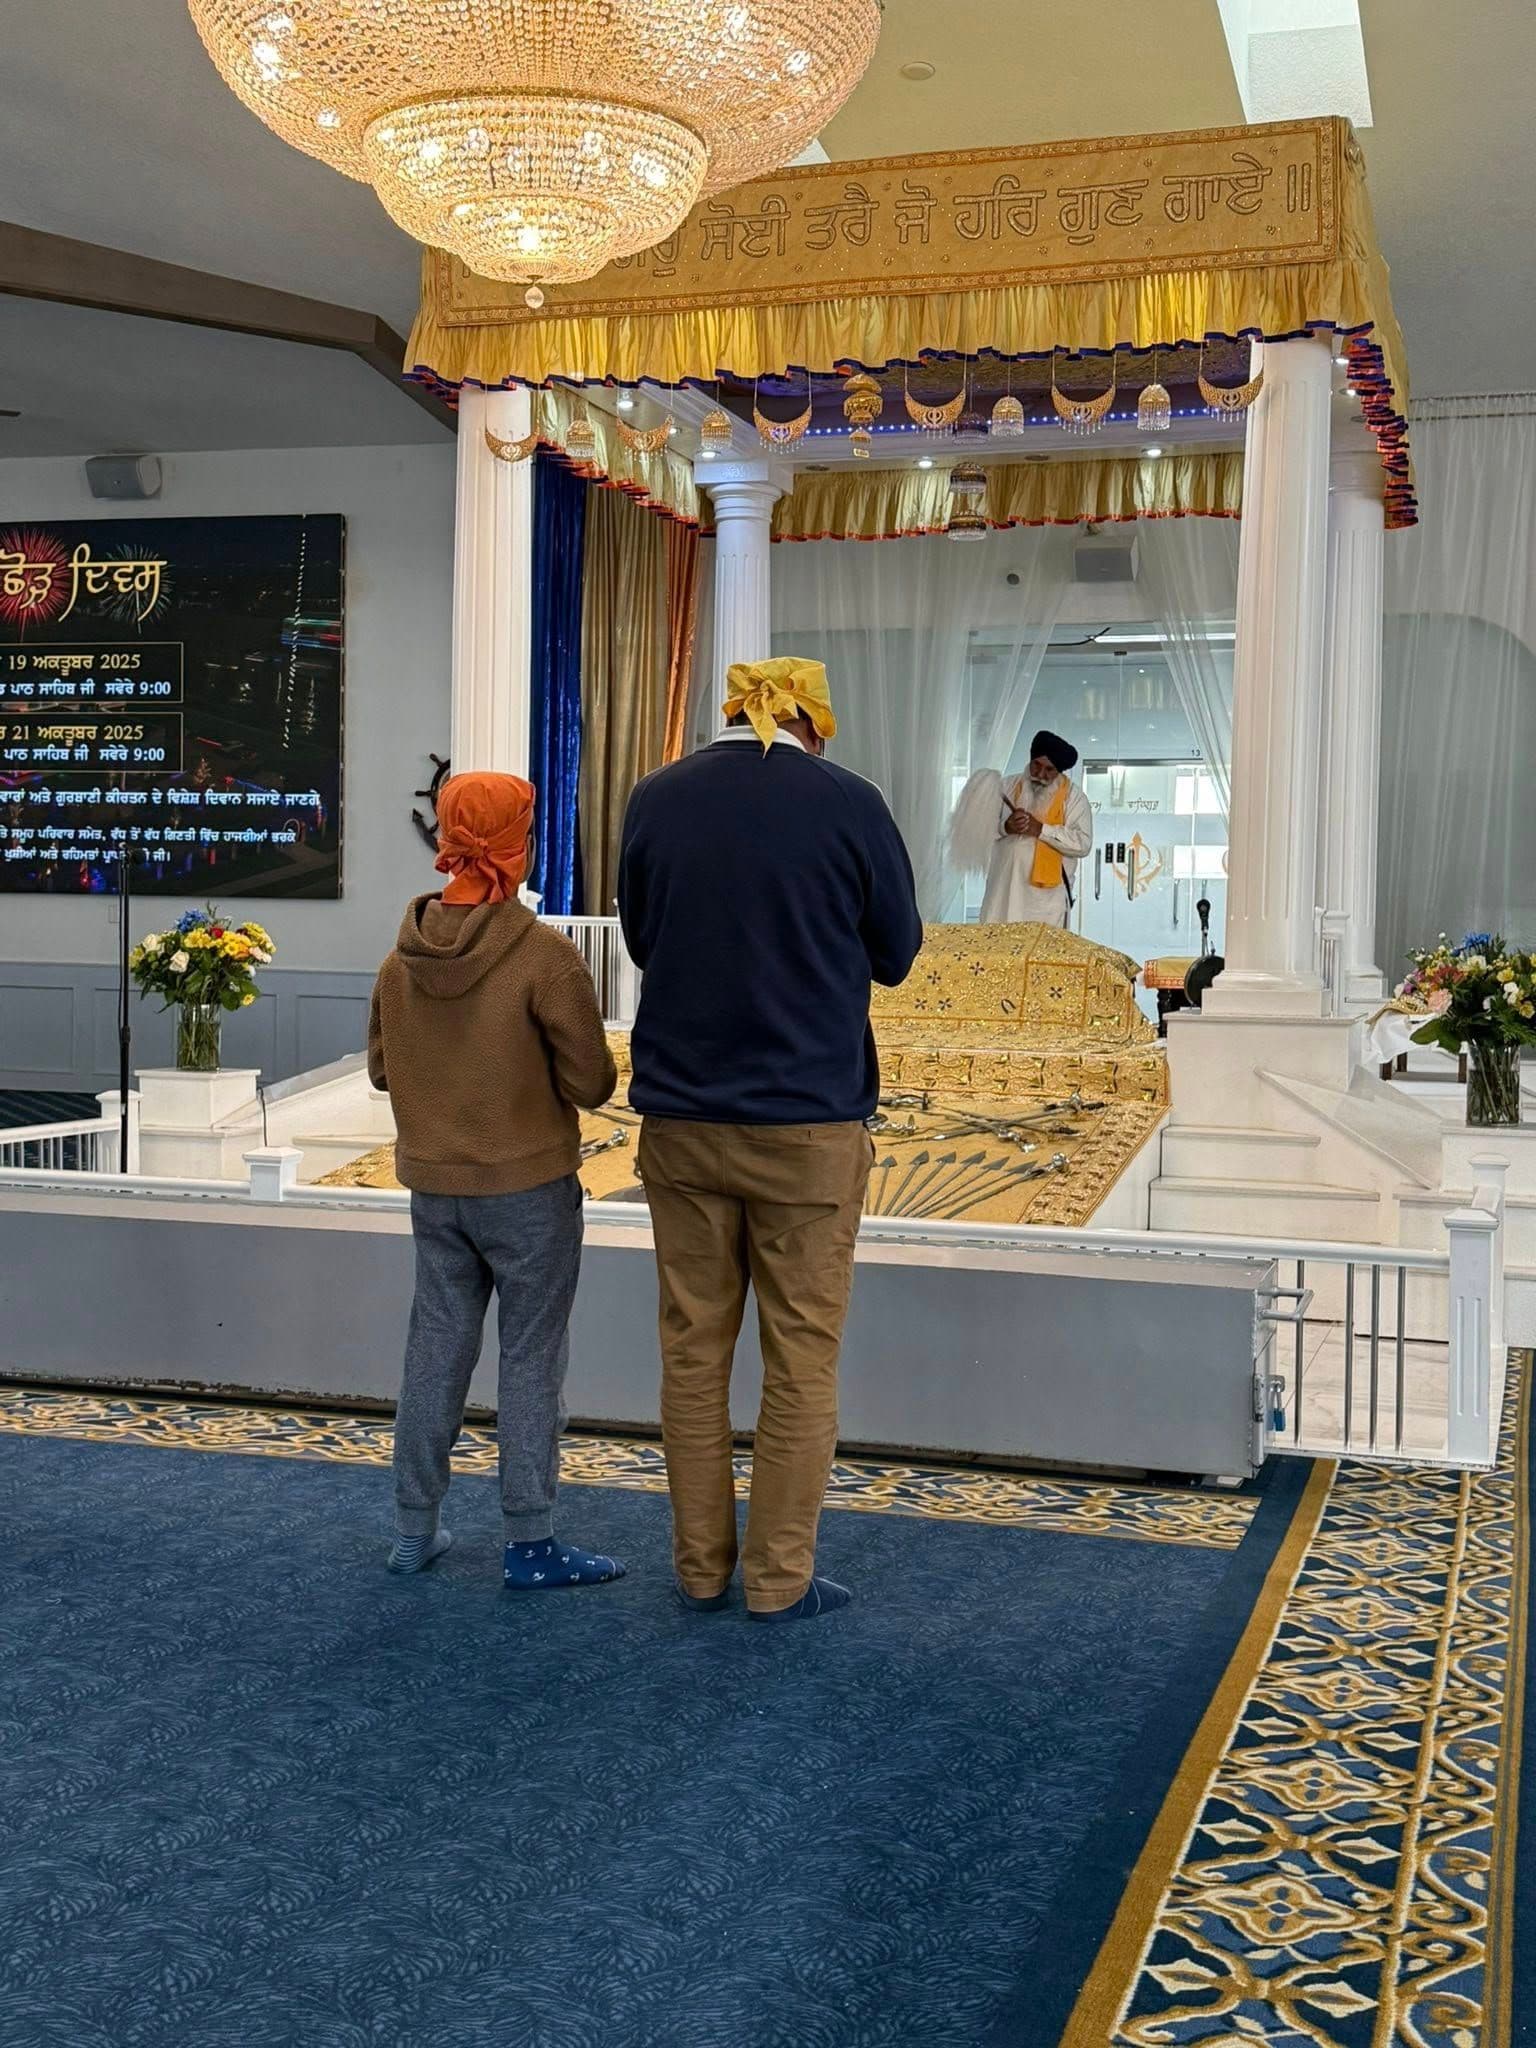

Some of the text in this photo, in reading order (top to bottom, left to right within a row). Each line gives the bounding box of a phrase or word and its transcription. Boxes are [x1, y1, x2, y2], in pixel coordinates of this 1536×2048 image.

[700, 194, 791, 261] ਸੋਈ
[805, 182, 880, 252] ਤਰੈ
[895, 178, 938, 244] ਜੋ
[953, 173, 1047, 241] ਹਰਿ
[1057, 179, 1149, 245] ਗੁਣ
[1162, 152, 1273, 222] ਗਾਏ
[58, 543, 168, 622] ਦਿਵਸ
[9, 655, 27, 670] 19
[32, 655, 95, 676] ਅਕਤੂਬਰ
[100, 654, 141, 669] 2025
[11, 682, 34, 695] ਪਾਠ
[39, 678, 76, 695] ਸਾਹਿਬ
[80, 678, 95, 695] ਜੀ
[105, 678, 135, 695] ਸਵੇਰੇ
[139, 682, 171, 695] 9:00
[12, 726, 29, 740] 21
[38, 726, 98, 747] ਅਕਤੂਬਰ
[104, 725, 144, 740] 2025
[4, 744, 165, 761] ਪਾਠ ਸਾਹਿਬ ਜੀ ਸਵੇਰੇ 9:00
[29, 787, 51, 804] ਅਤੇ
[55, 787, 101, 806] ਗੁਰਬਾਣੀ
[105, 788, 148, 804] ਕੀਰਤਨ
[152, 788, 163, 804] ਦੇ
